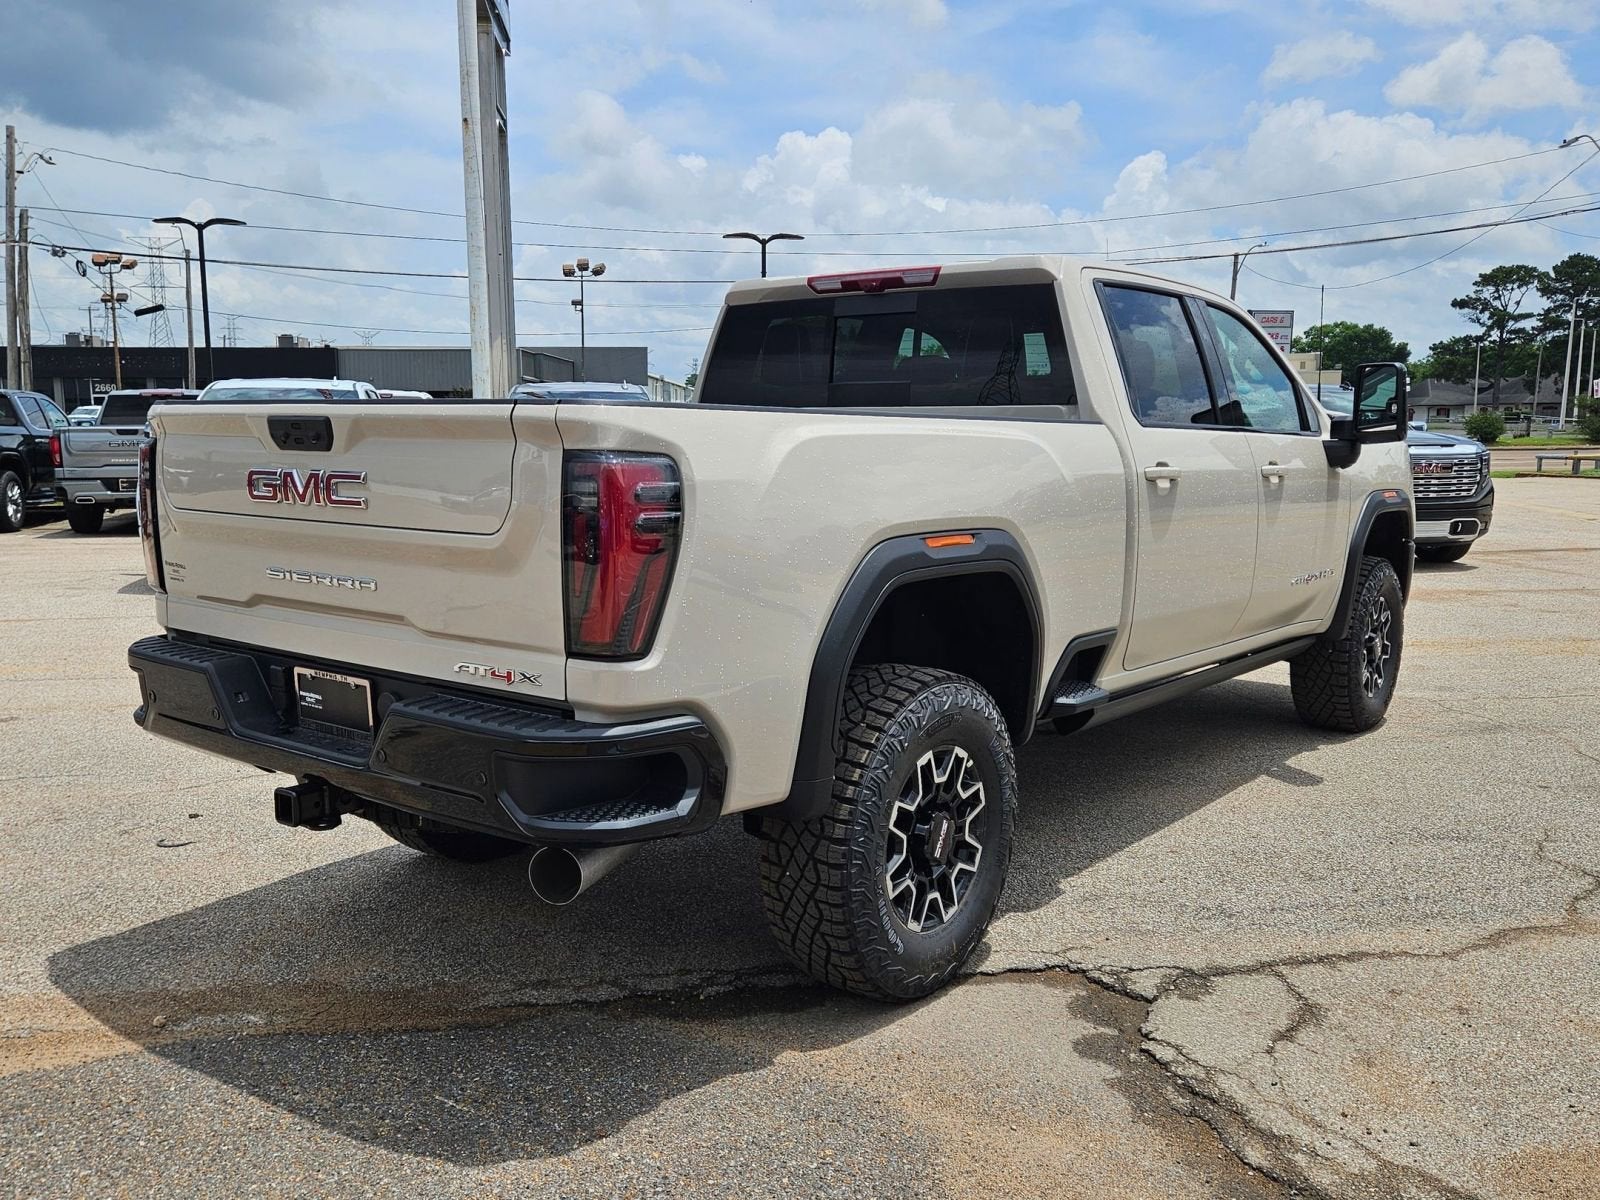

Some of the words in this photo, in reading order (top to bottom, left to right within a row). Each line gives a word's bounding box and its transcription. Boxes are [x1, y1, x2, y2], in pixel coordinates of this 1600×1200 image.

[95, 384, 116, 392] 2660
[1412, 463, 1452, 474] GMC
[247, 468, 368, 509] GMC
[265, 566, 378, 592] SIERRA
[453, 661, 543, 687] AT4X
[934, 819, 948, 858] GMC
